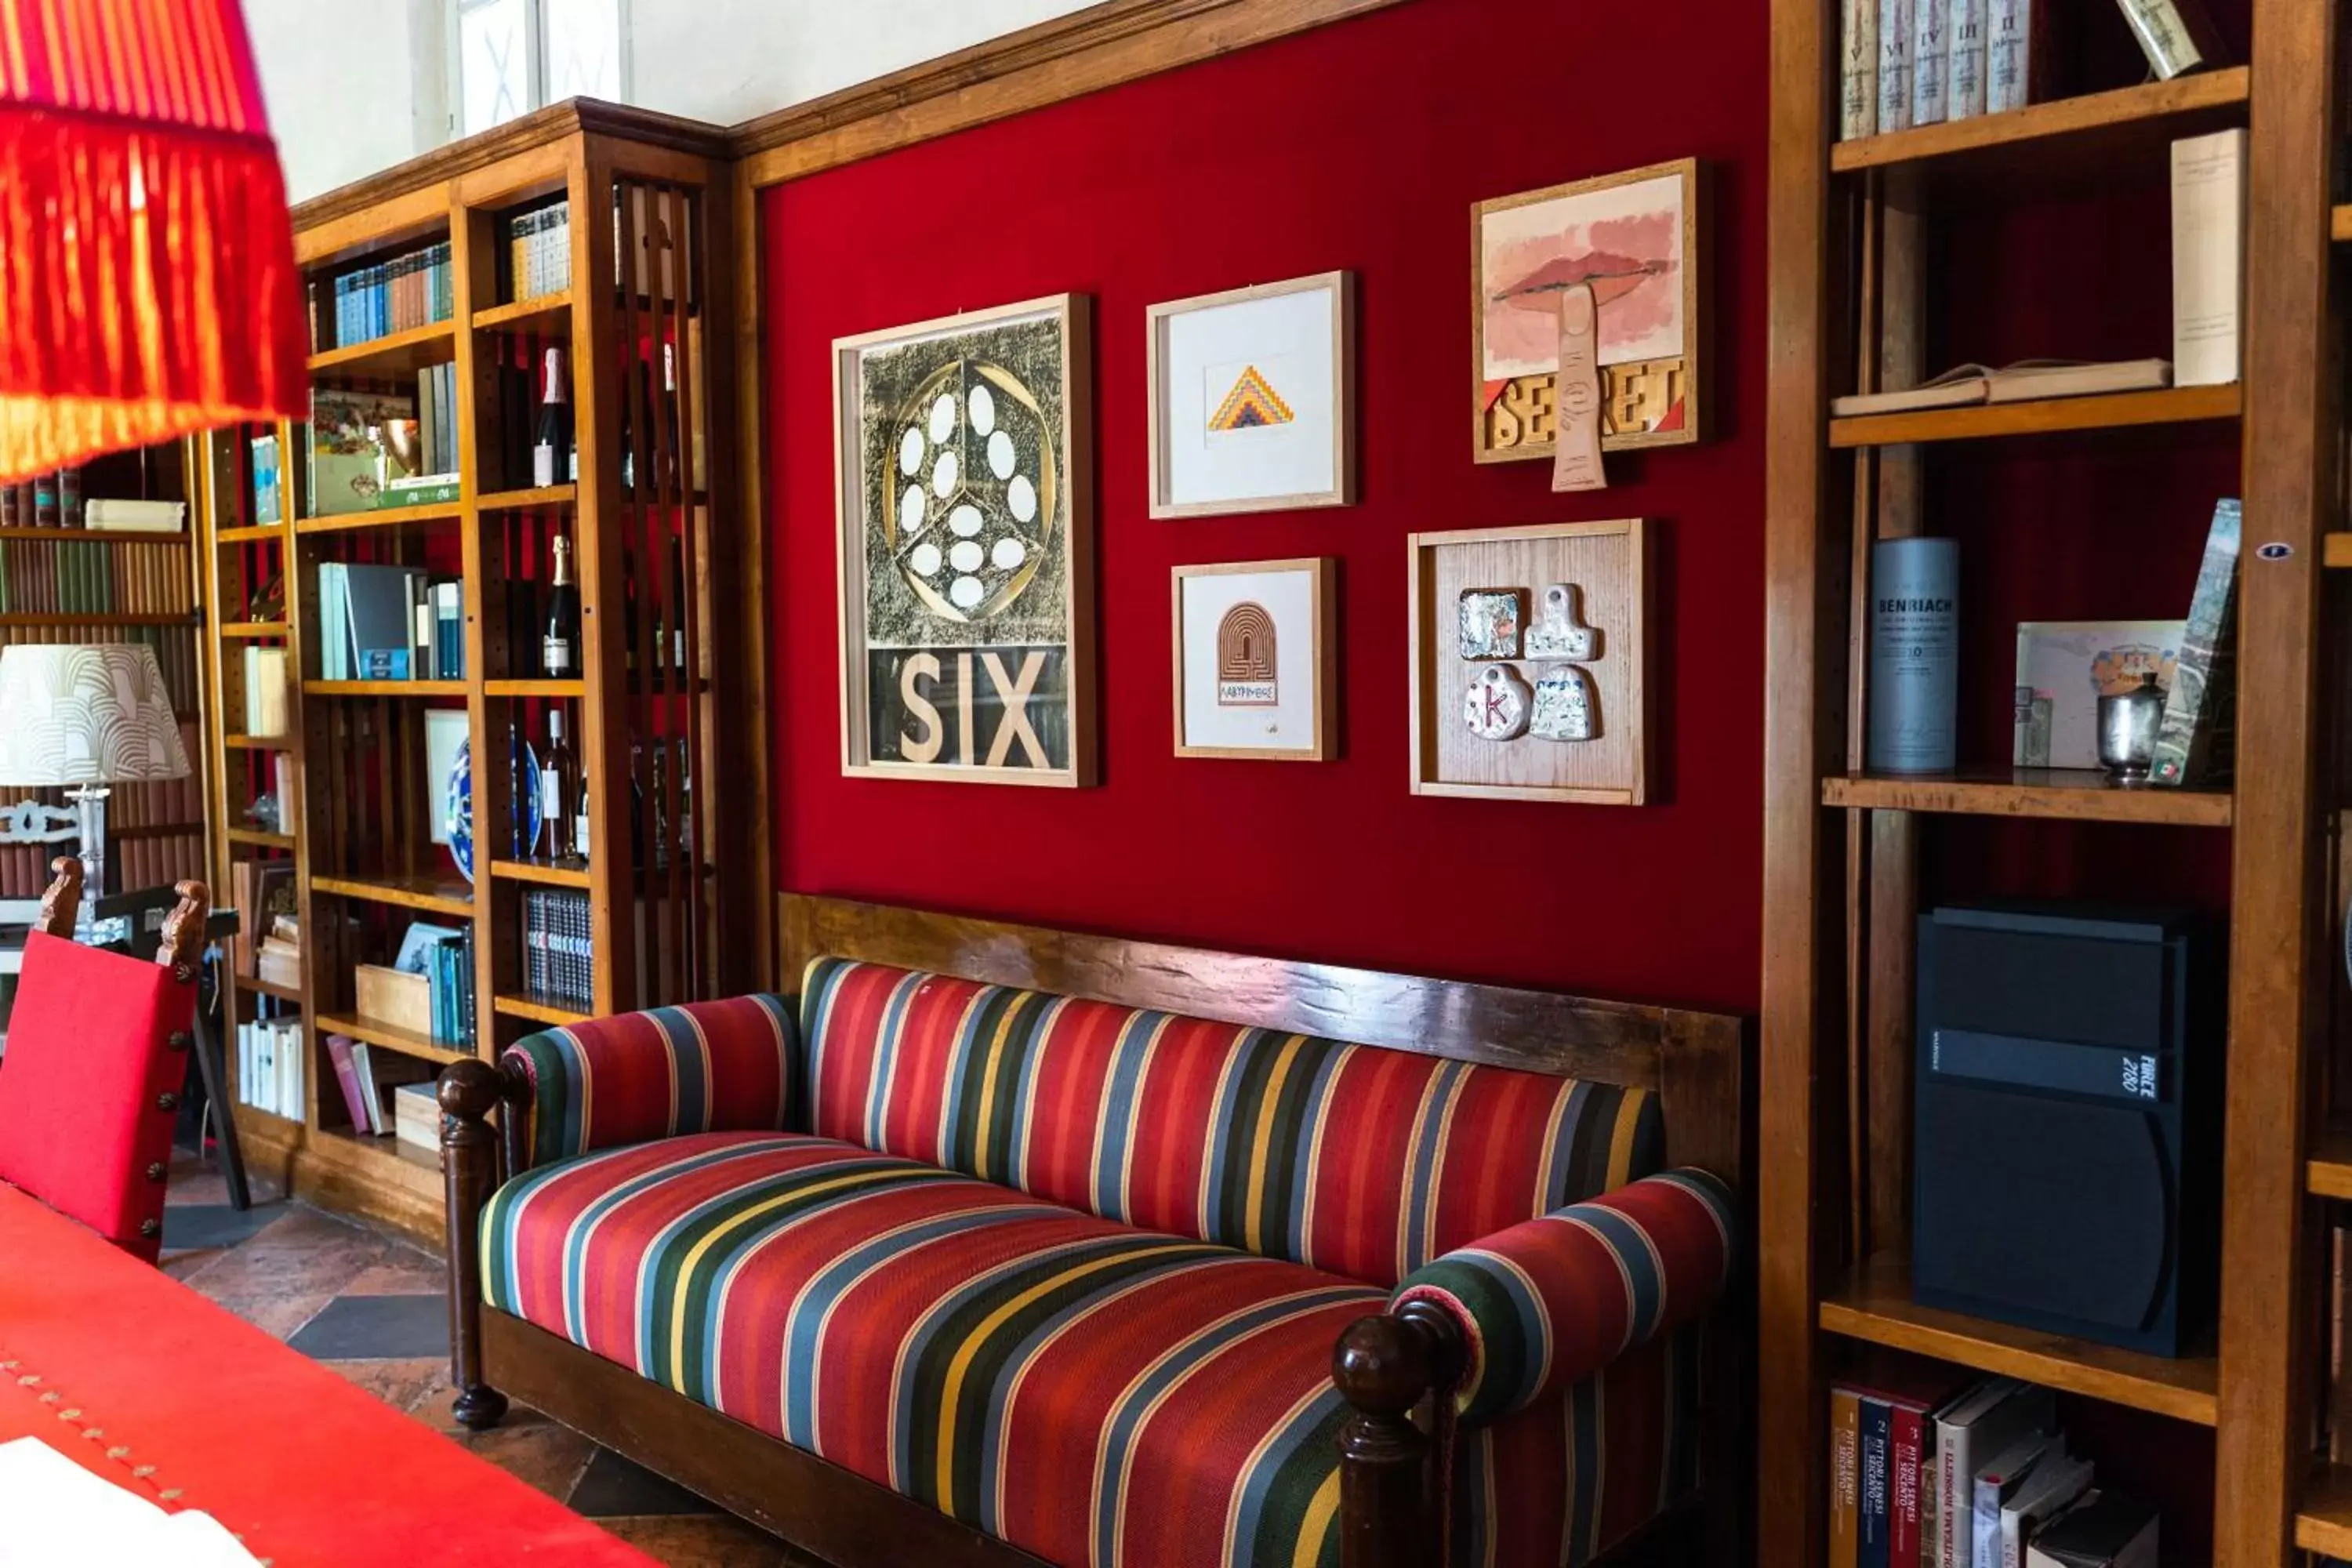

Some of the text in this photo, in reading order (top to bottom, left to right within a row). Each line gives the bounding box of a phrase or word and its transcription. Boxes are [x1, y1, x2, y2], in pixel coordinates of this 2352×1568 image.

[1493, 360, 1685, 448] SERET
[1878, 598, 1953, 613] BENRIACH
[899, 650, 1051, 768] SIX
[1486, 684, 1508, 728] K
[2140, 1055, 2157, 1098] FORCE
[1867, 1454, 1877, 1498] SEICENTO
[1875, 1438, 1885, 1515] PITTORI SENESI
[1899, 1461, 1908, 1507] SEICENTO
[1906, 1445, 1917, 1523] PITTORI SENESI
